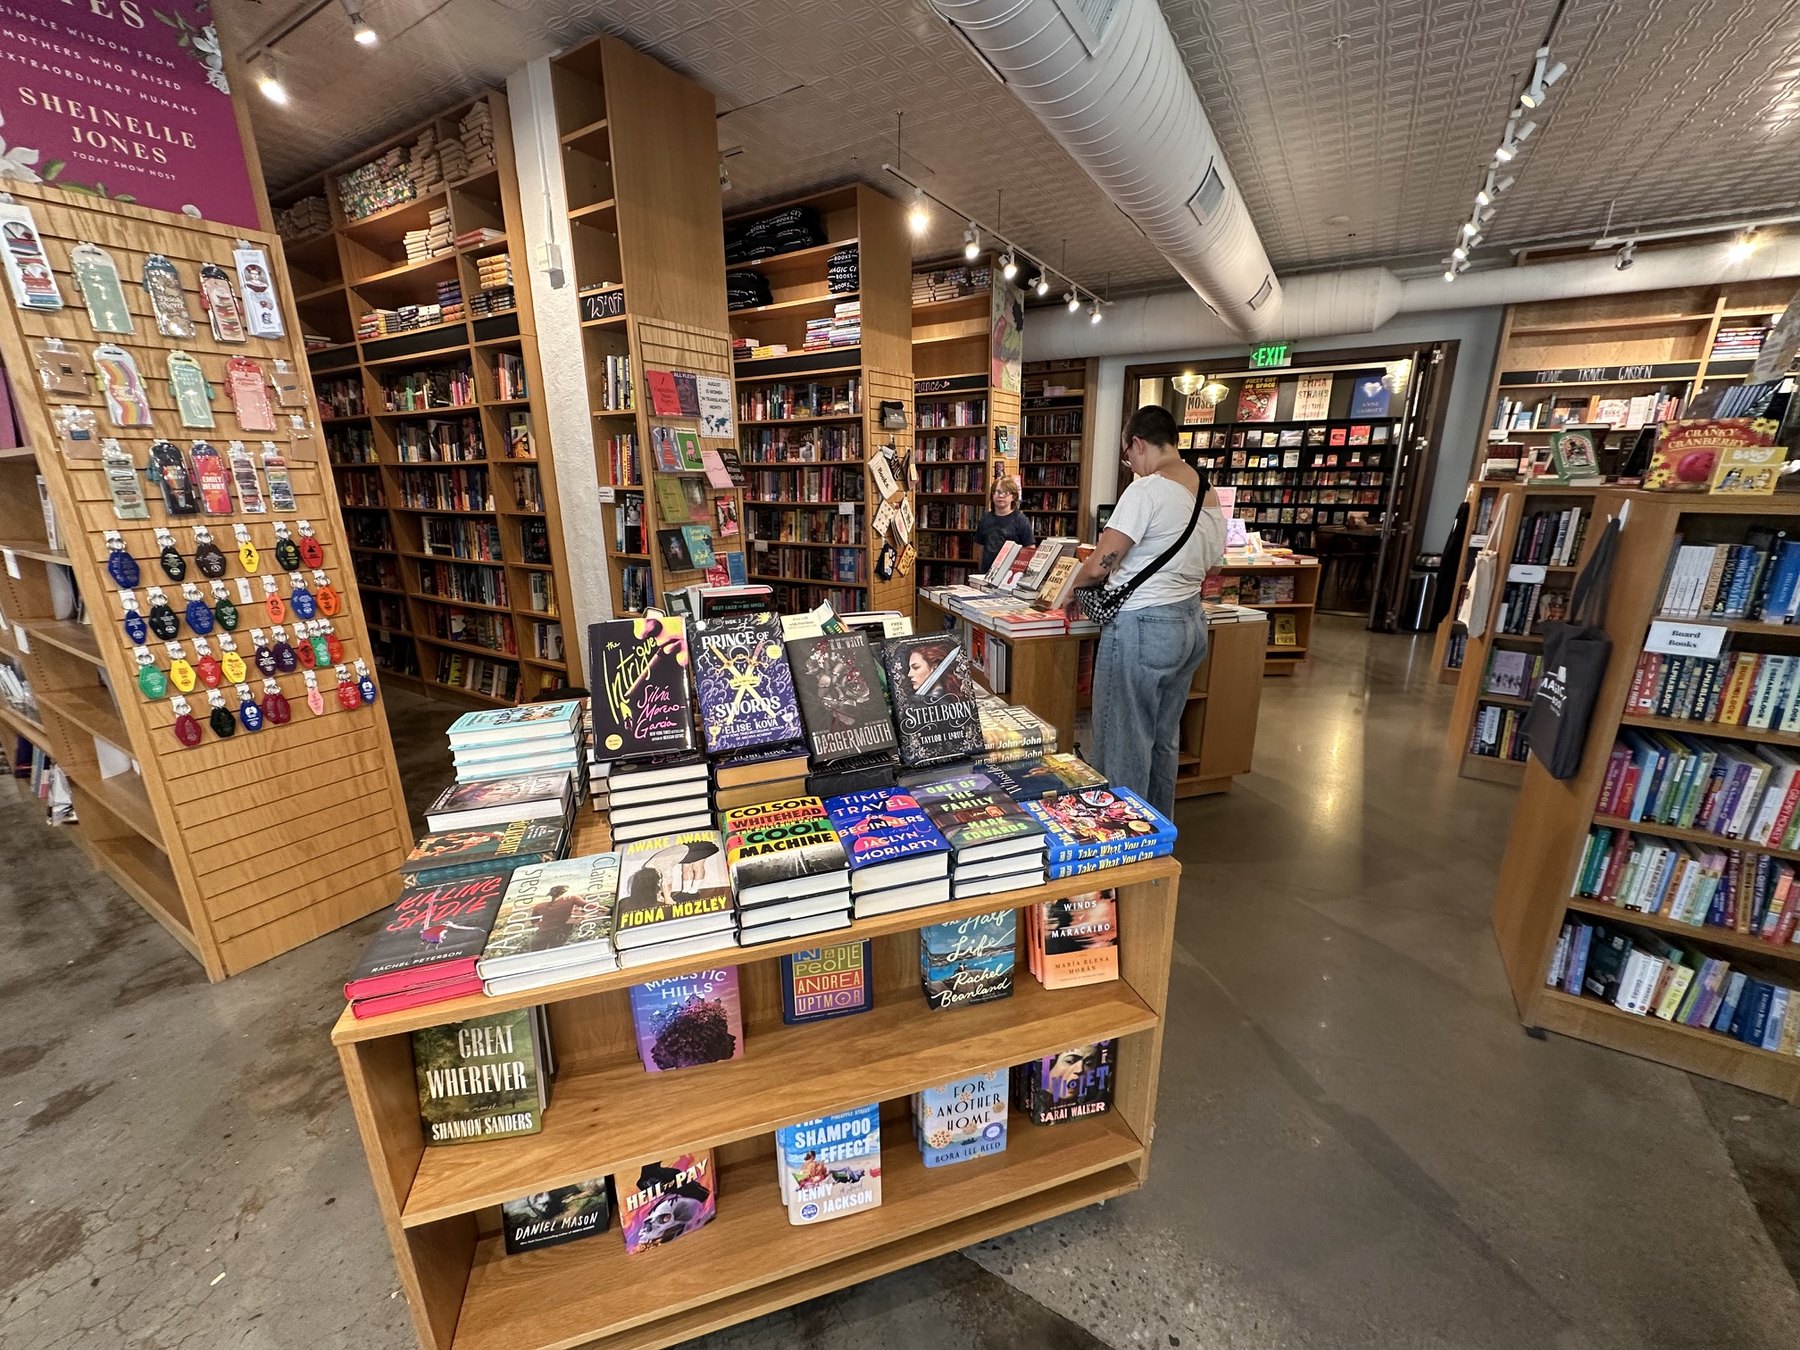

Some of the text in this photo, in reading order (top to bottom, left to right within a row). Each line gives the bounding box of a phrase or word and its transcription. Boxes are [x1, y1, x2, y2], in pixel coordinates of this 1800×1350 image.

[3, 29, 181, 91] MOTHERS WHO RAISED
[67, 27, 129, 54] WISDOM
[137, 51, 175, 70] FROM
[140, 93, 197, 115] HUMANS
[18, 86, 196, 149] SHEINELLE
[72, 126, 167, 164] JONES
[72, 151, 176, 181] TODAY SHOW HOST
[1257, 346, 1287, 367] EXIT
[1535, 365, 1653, 383] HOME TRAVEL GARDEN
[1667, 437, 1750, 450] CRANBERRY
[1685, 428, 1738, 438] CRANKY
[605, 641, 621, 651] the
[701, 630, 770, 650] PRINCE OF
[1668, 640, 1697, 648] Books
[1671, 630, 1701, 639] Board
[602, 637, 658, 725] Intrigue
[1661, 660, 1681, 709] ALPHABLOCK
[1694, 663, 1715, 713] ALPHABLOCK
[637, 684, 670, 708] Silvia
[715, 696, 781, 719] SWORDS
[634, 716, 678, 739] Garcia
[725, 718, 779, 735] ELISE KOVA
[904, 703, 974, 729] STEELBORN
[812, 723, 893, 755] DAGGERMOUTH
[921, 734, 942, 744] TAYLOR
[998, 740, 1018, 750] John
[1021, 736, 1042, 746] John
[1001, 753, 1020, 762] John
[1024, 749, 1043, 758] John
[841, 790, 890, 805] TIME
[925, 779, 977, 794] ONE OF
[945, 789, 975, 801] THE
[730, 798, 818, 819] COLSON
[834, 798, 908, 817] TRAVEL
[941, 796, 995, 812] FAMILY
[732, 808, 822, 829] WHITEHEAD
[838, 815, 925, 838] BEGINNERS
[967, 816, 1008, 830] MARK
[746, 821, 827, 844] COOL
[864, 830, 919, 848] JACLYN
[962, 822, 1028, 841] EDWARDS
[627, 838, 670, 855] AWAKE
[739, 833, 834, 860] MACHINE
[855, 838, 938, 863] MORIARTY
[1077, 848, 1098, 859] Take
[1100, 843, 1122, 858] What
[1124, 841, 1139, 851] You
[1140, 839, 1157, 847] Can
[1077, 863, 1096, 875] Take
[1099, 857, 1120, 872] What
[1122, 855, 1136, 865] You
[1138, 851, 1154, 860] Can
[394, 876, 502, 912] KILLING
[571, 856, 618, 939] Claire Boyles
[1064, 900, 1097, 911] WINDS
[386, 891, 500, 932] SADIE
[620, 896, 727, 929] FIONA MOZLEY
[1051, 923, 1111, 939] MARACAIBO
[947, 927, 1016, 962] Life
[371, 950, 463, 973] RACHEL PETERSON
[1083, 956, 1110, 966] ELENA
[797, 971, 861, 993] ANDREA
[950, 963, 1014, 990] Rachel
[661, 983, 714, 1000] HILLS
[799, 989, 861, 1012] UPTMOR
[931, 980, 1012, 1008] Beanland
[458, 1024, 514, 1059] GREAT
[426, 1061, 527, 1099] WHEREVER
[953, 1080, 986, 1099] FOR
[1051, 1066, 1111, 1103] VIOLET
[936, 1093, 1001, 1118] ANOTHER
[1040, 1101, 1106, 1123] SARAI WALKER
[432, 1112, 533, 1141] SHANNON SANDERS
[947, 1111, 991, 1132] HOME
[794, 1118, 871, 1149] SHAMPOO
[820, 1137, 871, 1163] EFFECT
[935, 1151, 961, 1164] BORA
[964, 1146, 978, 1158] LEE
[626, 1158, 709, 1212] HELL TO PAY
[797, 1183, 833, 1202] JENNY
[822, 1190, 873, 1214] JACKSON
[514, 1212, 599, 1241] DANIEL MASON
